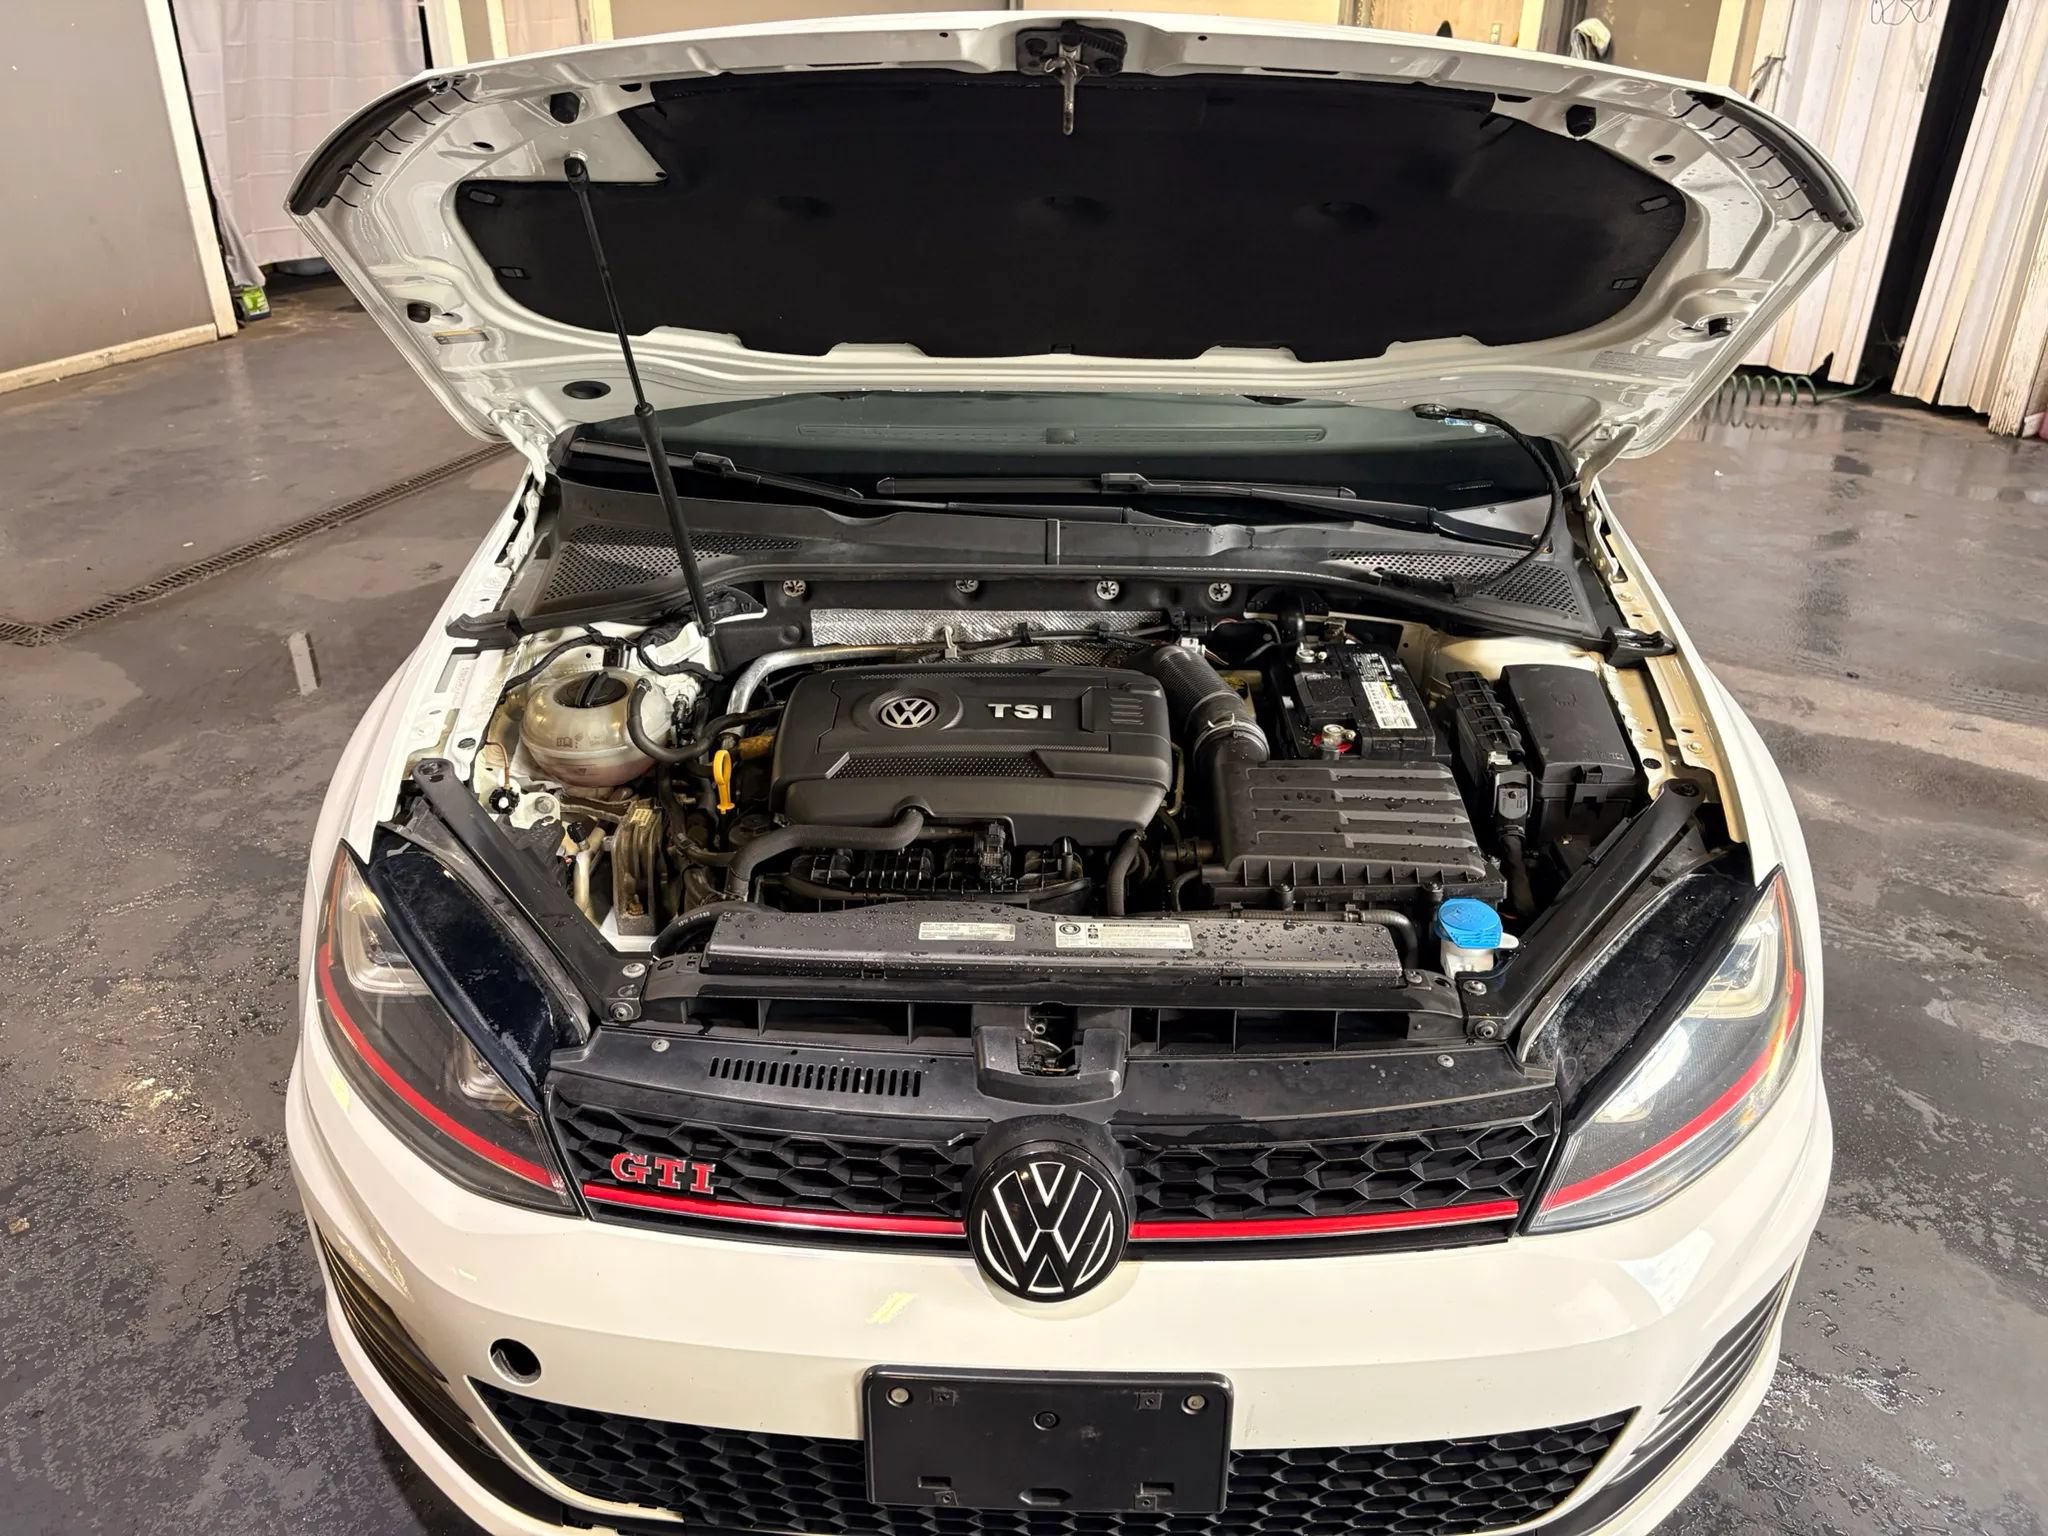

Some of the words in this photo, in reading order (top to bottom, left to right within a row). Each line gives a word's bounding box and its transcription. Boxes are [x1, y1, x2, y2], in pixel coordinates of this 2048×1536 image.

[881, 698, 936, 729] VW
[987, 703, 1052, 719] TSI
[610, 1151, 716, 1194] GTI
[980, 1160, 1115, 1294] VW
